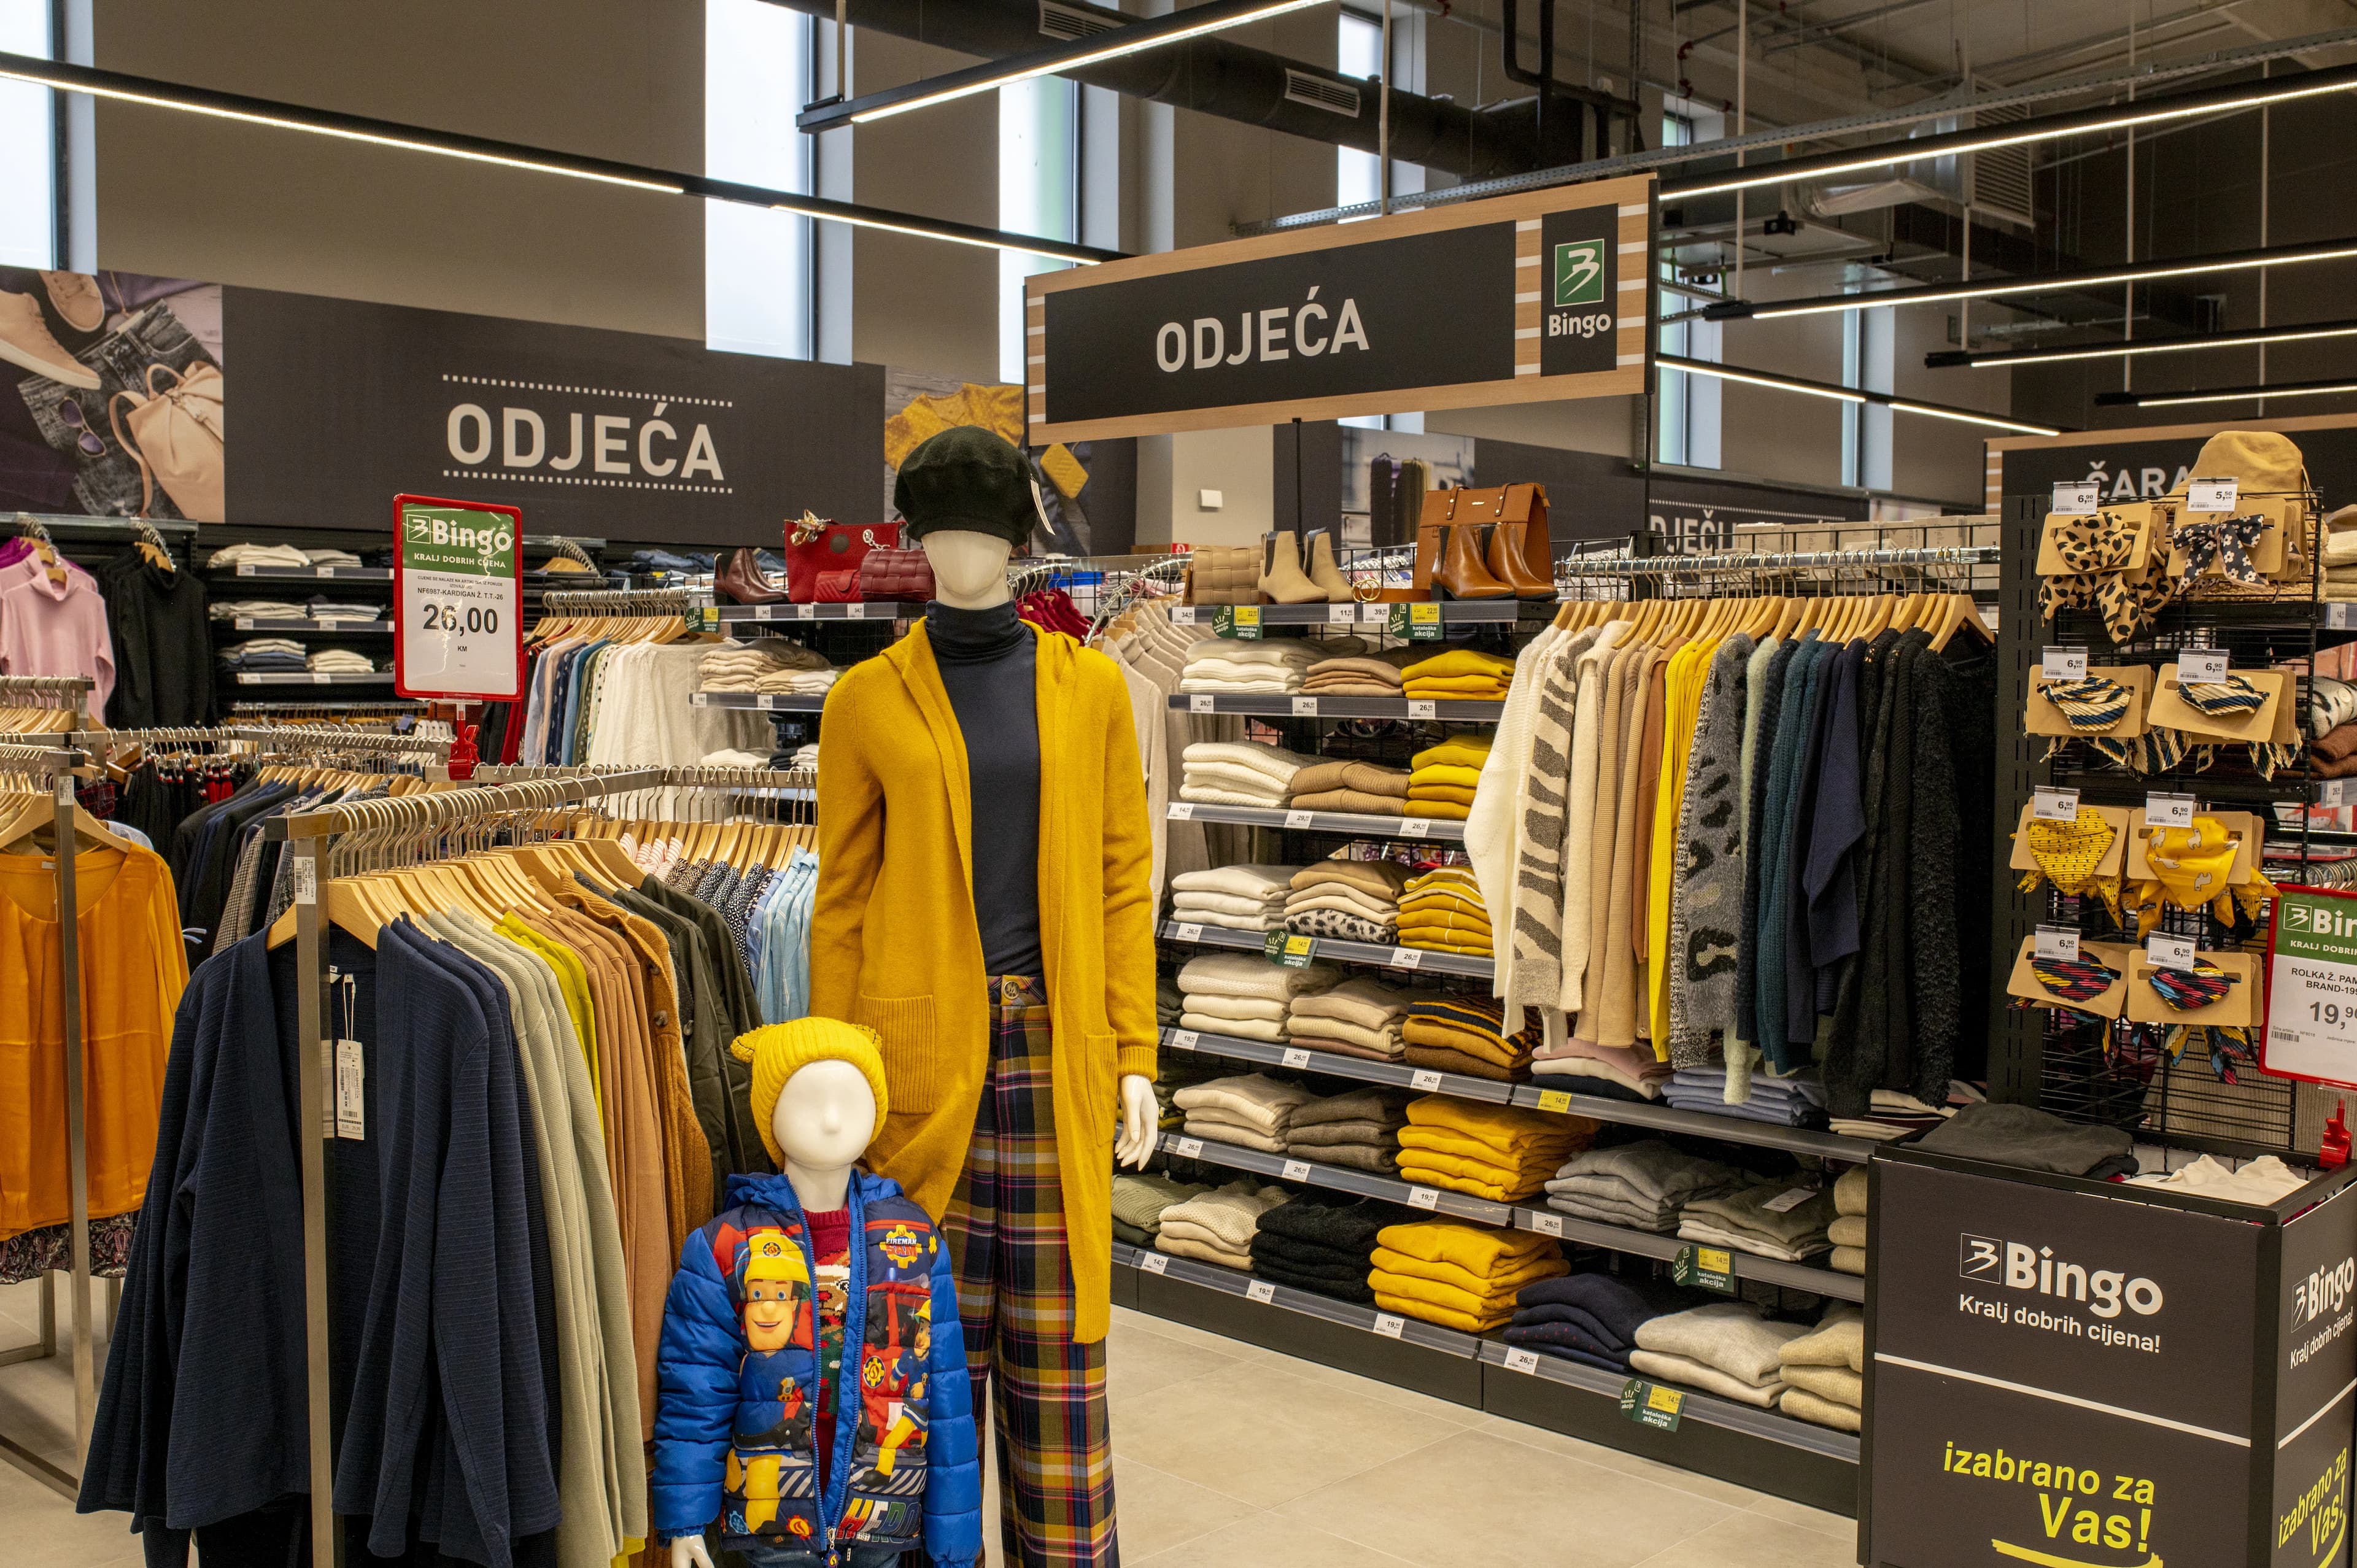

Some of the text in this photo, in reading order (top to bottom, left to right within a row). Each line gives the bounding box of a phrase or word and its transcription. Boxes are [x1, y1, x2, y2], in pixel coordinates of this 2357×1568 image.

[1156, 285, 1370, 373] ODJEĆA
[1549, 312, 1611, 338] Bingo
[447, 402, 724, 481] ODJEĆA
[2078, 495, 2093, 506] 6,90
[2215, 491, 2232, 501] 5,50
[432, 519, 513, 555] Bingo
[414, 552, 439, 562] KRALJ
[443, 555, 474, 565] DOBRIH
[417, 587, 476, 598] NF6987-KARDIGAN
[422, 604, 498, 637] 26,00
[2067, 659, 2083, 670] 6,90
[2205, 662, 2223, 673] 6,90
[2057, 801, 2073, 811] 6,90
[2172, 806, 2188, 817] 6,90
[2059, 940, 2074, 949] 6,90
[2290, 940, 2320, 951] KRALJ
[2173, 948, 2190, 958] 6,90
[2291, 968, 2325, 981] ROLKA
[2328, 971, 2336, 982] Ž.
[1699, 1278, 1724, 1288] akcija
[2005, 1242, 2163, 1318] Bingo
[2308, 1257, 2355, 1322] Bingo
[1959, 1294, 2160, 1353] Kralj dobrih cijena!
[2290, 1305, 2353, 1369] Kralj dobrih cijena!
[1643, 1416, 1668, 1427] akcija
[1944, 1441, 2155, 1505] izabrano za
[2278, 1447, 2347, 1549] izabrano za
[2312, 1474, 2345, 1556] Vas!
[2038, 1493, 2151, 1553] Vas!
